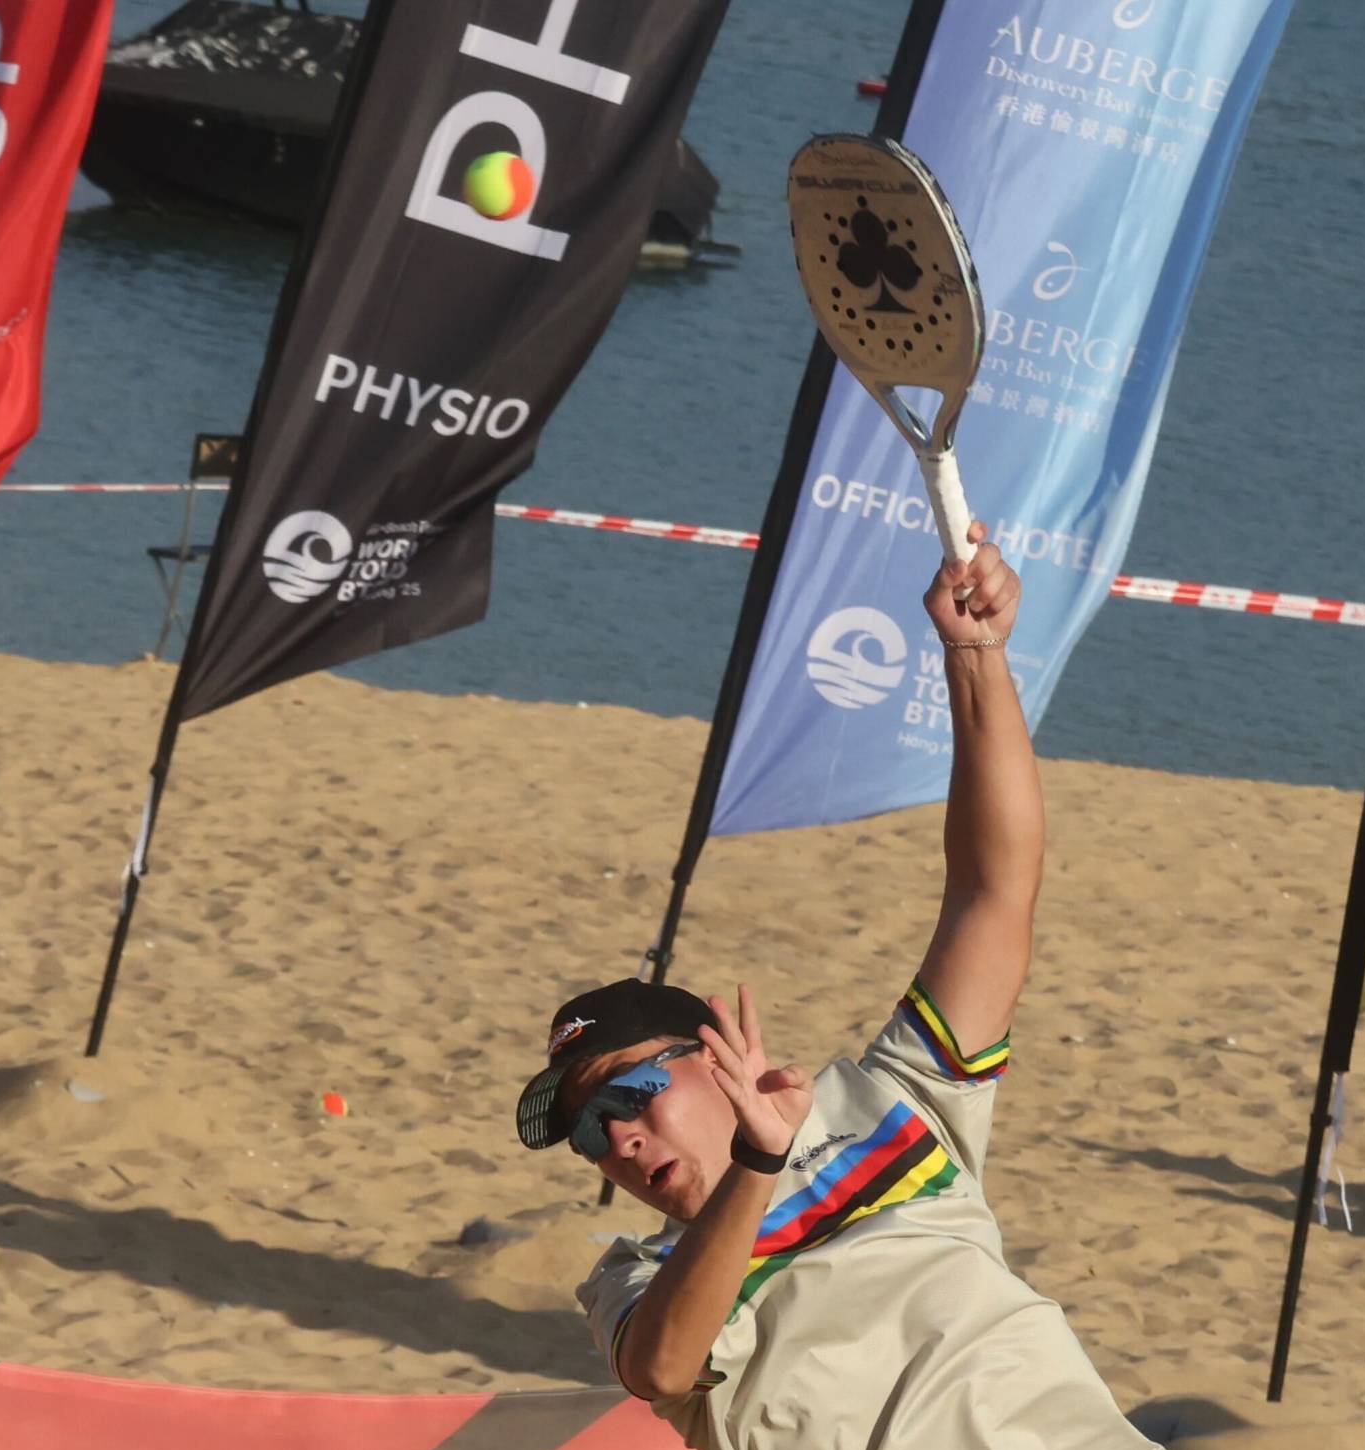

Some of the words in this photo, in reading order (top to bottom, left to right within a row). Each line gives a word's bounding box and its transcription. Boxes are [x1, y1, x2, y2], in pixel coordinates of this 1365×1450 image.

[986, 55, 1088, 104] Discovery
[990, 15, 1227, 112] AUBERGE
[315, 354, 531, 440] PHYSIO
[994, 517, 1113, 575] HOTEL
